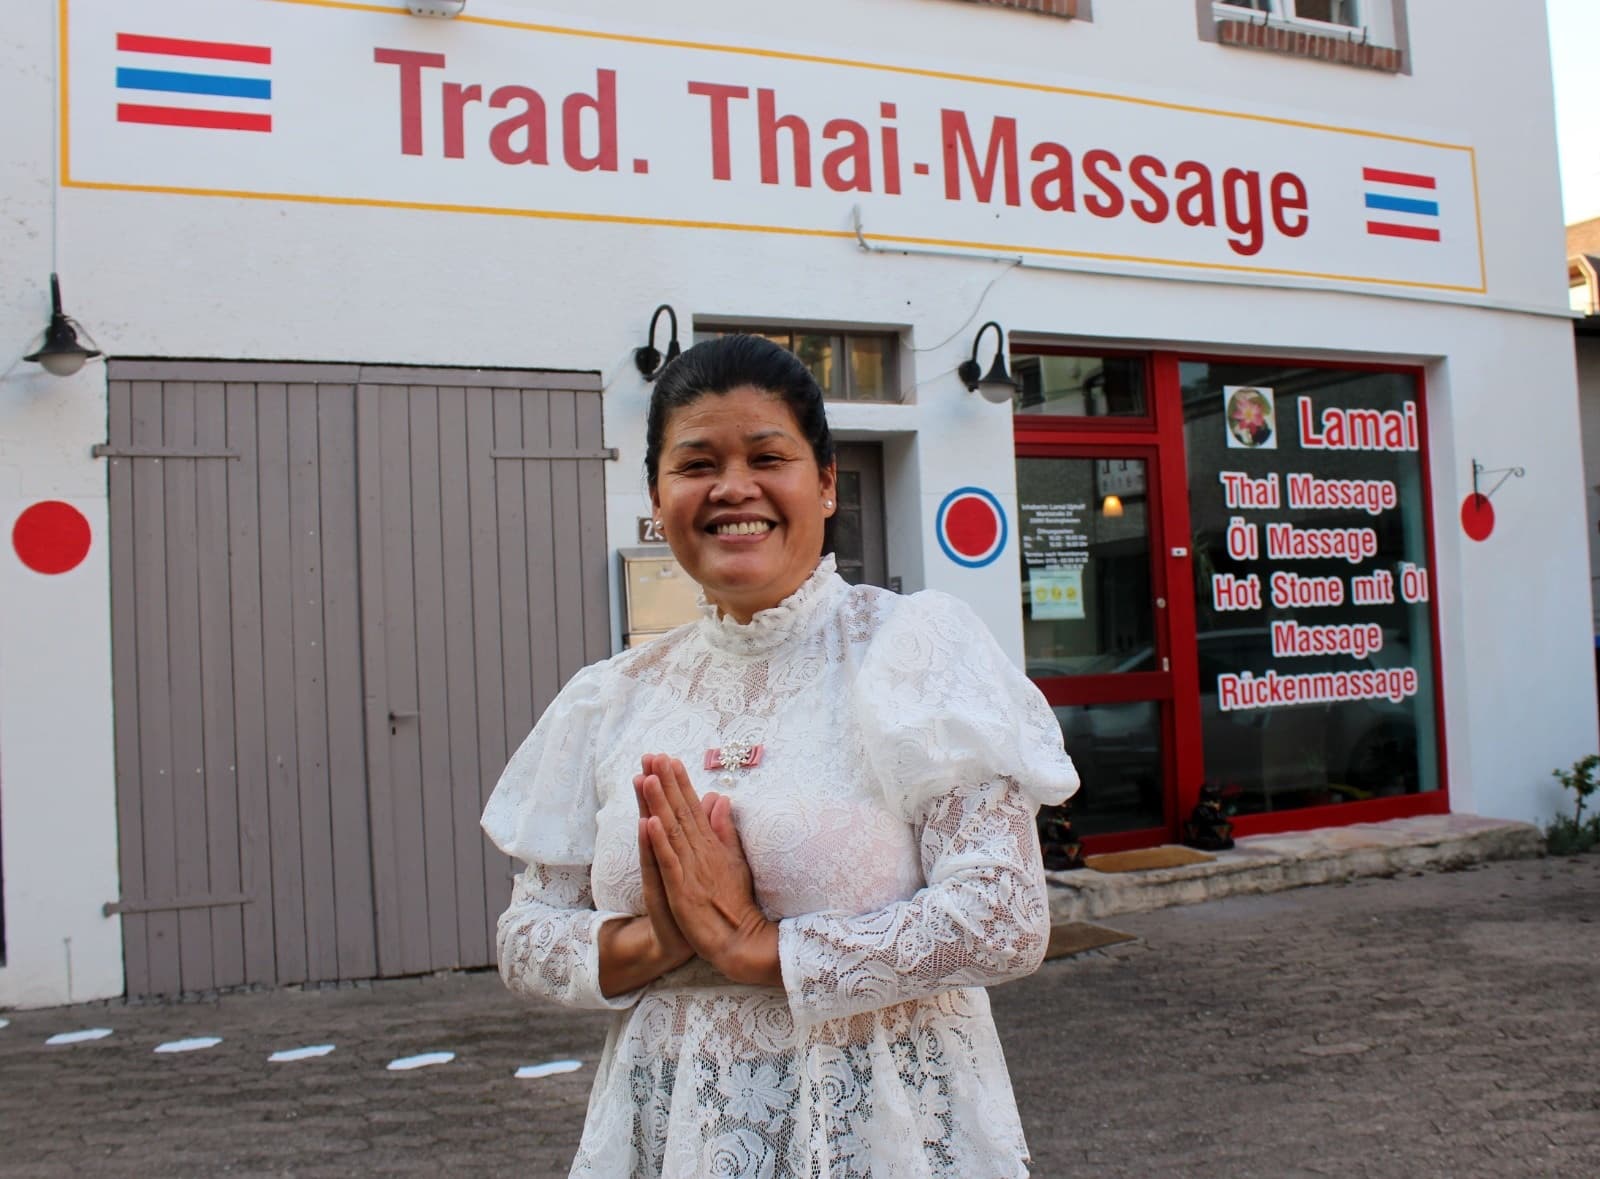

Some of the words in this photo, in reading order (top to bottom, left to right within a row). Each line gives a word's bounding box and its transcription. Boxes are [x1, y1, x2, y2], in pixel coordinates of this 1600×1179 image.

[375, 47, 649, 174] Trad.
[687, 81, 1309, 257] Thai-Massage
[1299, 397, 1418, 451] Lamai
[1222, 472, 1280, 507] Thai
[1288, 475, 1397, 513] Massage
[1228, 517, 1258, 560] Öl
[1267, 524, 1378, 562] Massage
[1213, 575, 1261, 610] Hot
[1272, 572, 1343, 607] Stone
[1353, 572, 1394, 603] mit
[1401, 562, 1428, 602] Öl
[1272, 621, 1382, 658] Massage
[1218, 666, 1418, 710] Rückenmassage
